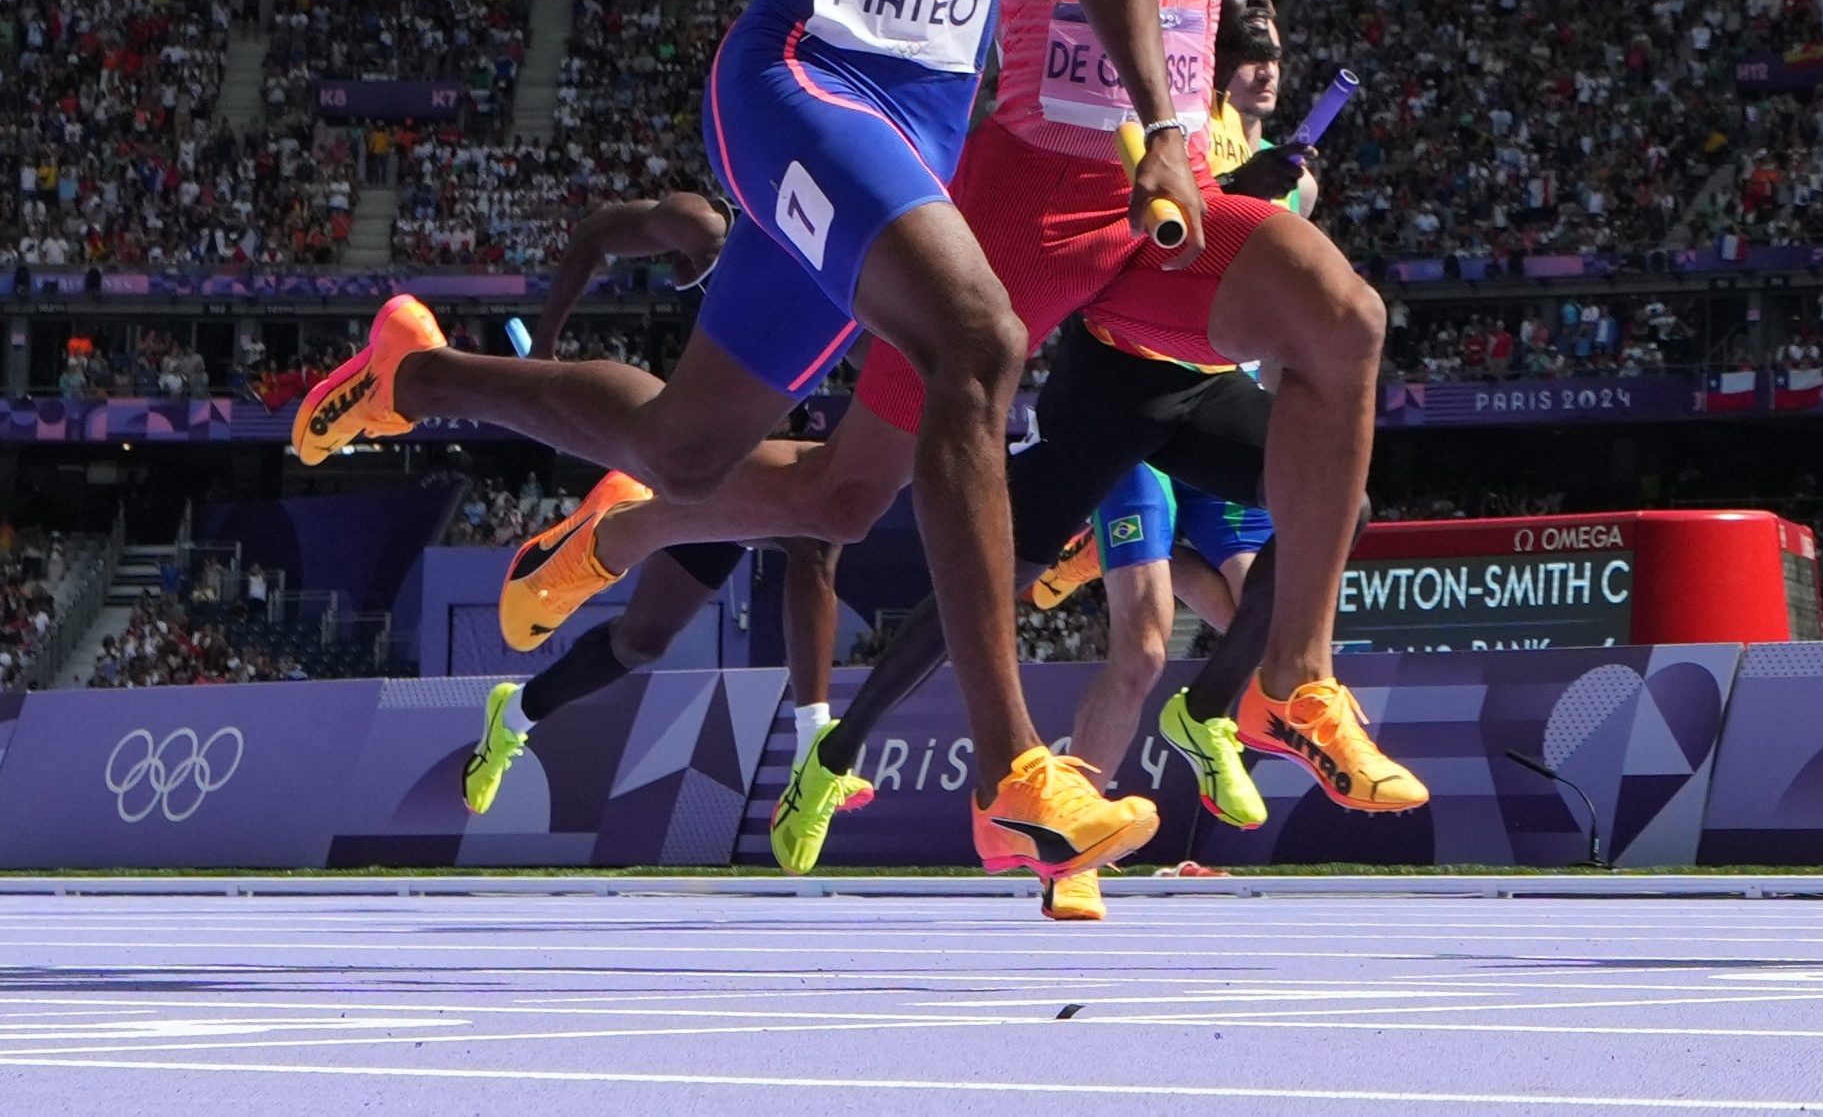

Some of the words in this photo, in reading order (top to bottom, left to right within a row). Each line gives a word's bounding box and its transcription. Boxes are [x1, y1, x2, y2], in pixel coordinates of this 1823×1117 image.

[1047, 40, 1090, 84] DE
[1098, 53, 1199, 95] GSSE
[1212, 132, 1250, 164] HAN
[787, 189, 816, 237] 7
[1474, 390, 1552, 411] PARIS
[1561, 387, 1631, 410] 2024
[1541, 525, 1624, 551] OMEGA
[1338, 561, 1593, 613] EWTON-SMITH
[1601, 559, 1630, 605] C
[1263, 709, 1352, 796] NITRO
